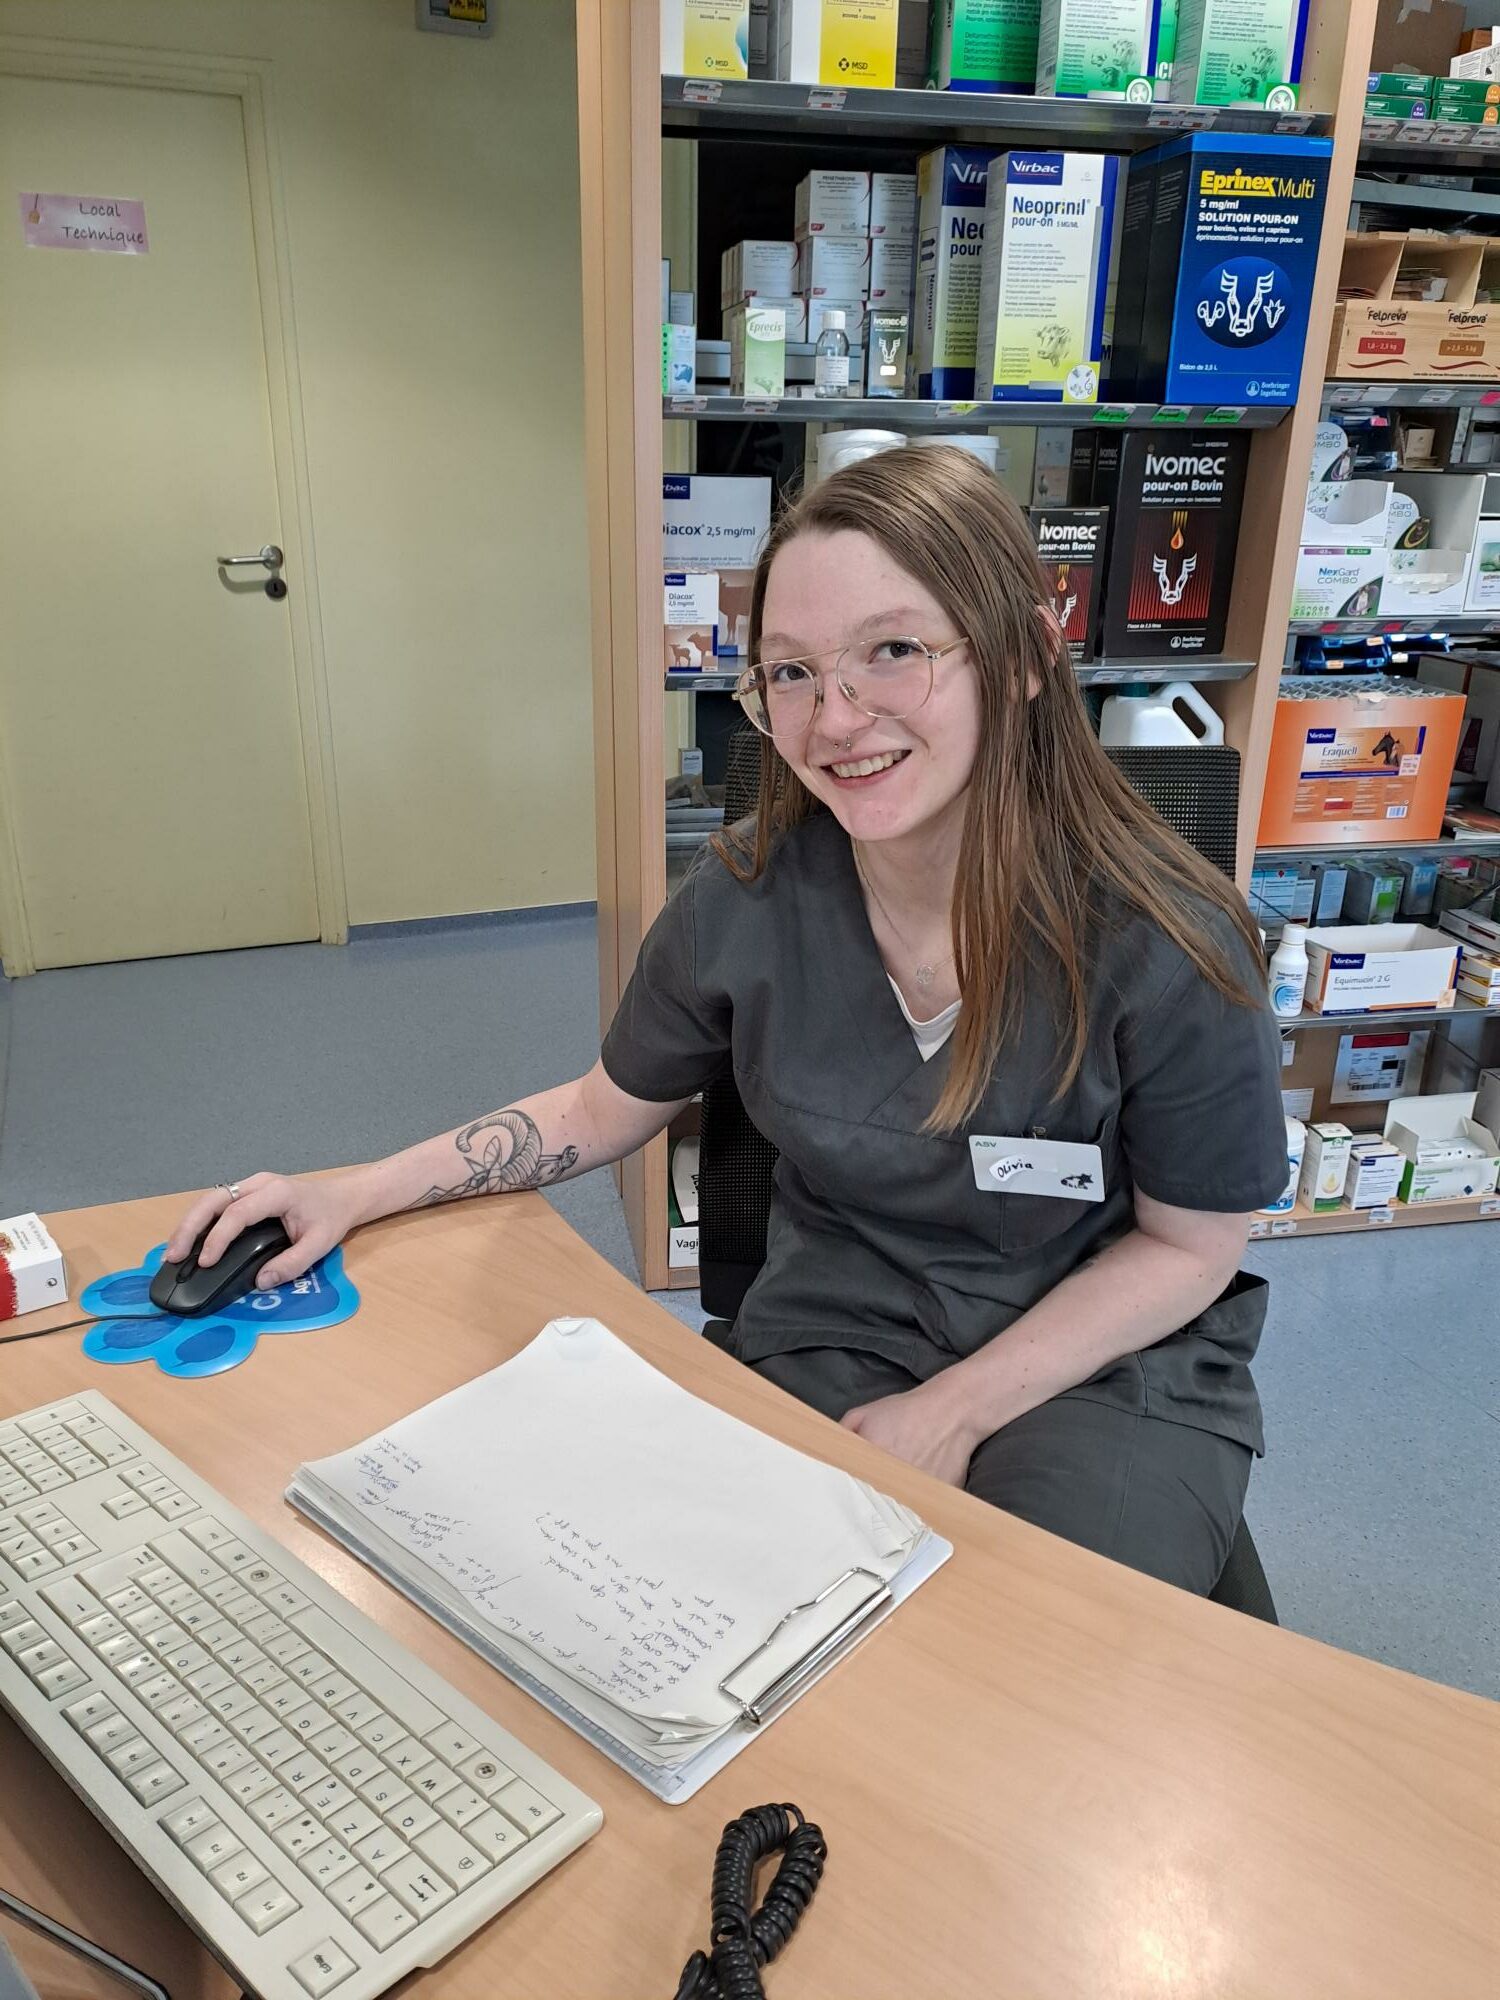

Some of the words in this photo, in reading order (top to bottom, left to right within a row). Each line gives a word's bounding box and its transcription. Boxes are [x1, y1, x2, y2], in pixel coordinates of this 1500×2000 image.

[852, 62, 868, 70] MSD
[1012, 160, 1060, 174] Virbac
[1200, 168, 1276, 197] Eprinex
[1278, 178, 1316, 198] Multi
[79, 202, 121, 217] Local
[1012, 196, 1086, 217] Neoprinil
[1200, 200, 1206, 208] 5
[1208, 200, 1239, 210] mg/ml
[1012, 216, 1054, 228] pour-on
[1198, 212, 1250, 223] SOLUTION
[1253, 214, 1299, 225] POUR-ON
[61, 224, 144, 248] Technique
[1368, 309, 1408, 322] Felpreva
[1448, 312, 1488, 324] Felpreva
[750, 322, 782, 334] Eprecis
[1142, 481, 1188, 493] pour-on
[1191, 480, 1223, 491] Bovin
[663, 522, 702, 536] iacox
[706, 526, 721, 538] 2,5
[724, 526, 756, 538] mg/ml
[1038, 543, 1070, 552] pour-on
[1072, 542, 1096, 550] Bovin
[1318, 567, 1360, 576] NexGard
[1317, 576, 1358, 585] COMBO
[1334, 956, 1364, 964] Virbac
[974, 1140, 997, 1148] ASV
[997, 1159, 1034, 1178] Olivia
[188, 1616, 200, 1624] M
[231, 1656, 242, 1664] K
[299, 1668, 312, 1676] N
[221, 1703, 232, 1711] U
[275, 1698, 288, 1707] H
[346, 1712, 357, 1720] V
[299, 1720, 310, 1728] G
[242, 1726, 254, 1734] Y
[372, 1734, 383, 1742] C
[397, 1756, 411, 1766] X
[292, 1772, 305, 1782] R
[350, 1768, 362, 1777] D
[421, 1780, 436, 1790] W
[376, 1792, 387, 1801] S
[317, 1798, 331, 1807] E
[528, 1807, 541, 1816] Ctrl
[403, 1817, 414, 1827] Q
[343, 1823, 357, 1833] Z
[211, 1844, 221, 1853] F3
[372, 1850, 385, 1859] A
[236, 1872, 248, 1881] F2
[263, 1901, 274, 1910] F1
